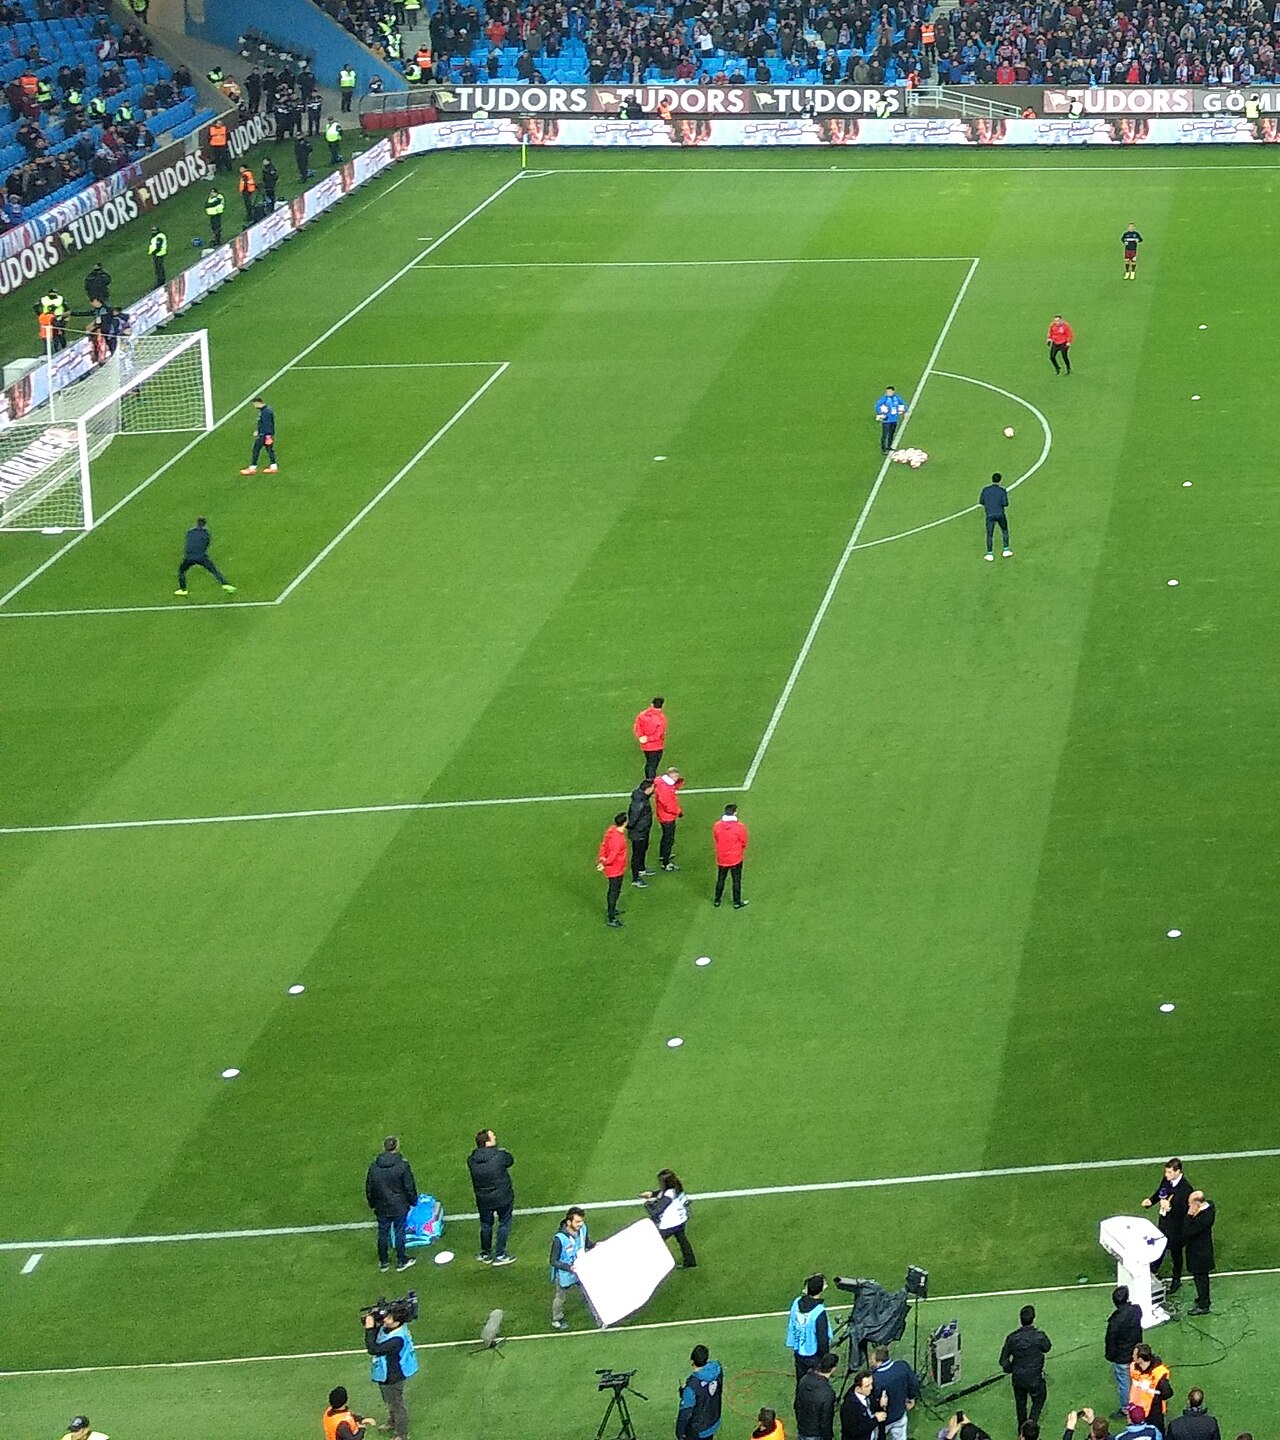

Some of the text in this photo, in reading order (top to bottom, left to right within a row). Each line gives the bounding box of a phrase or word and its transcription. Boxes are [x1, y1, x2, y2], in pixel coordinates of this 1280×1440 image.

[455, 88, 588, 112] TUDORS
[774, 88, 900, 112] TUDORS
[1067, 88, 1189, 112] TUDORS
[145, 150, 207, 205] TUDORS
[68, 190, 139, 250] TUDORS
